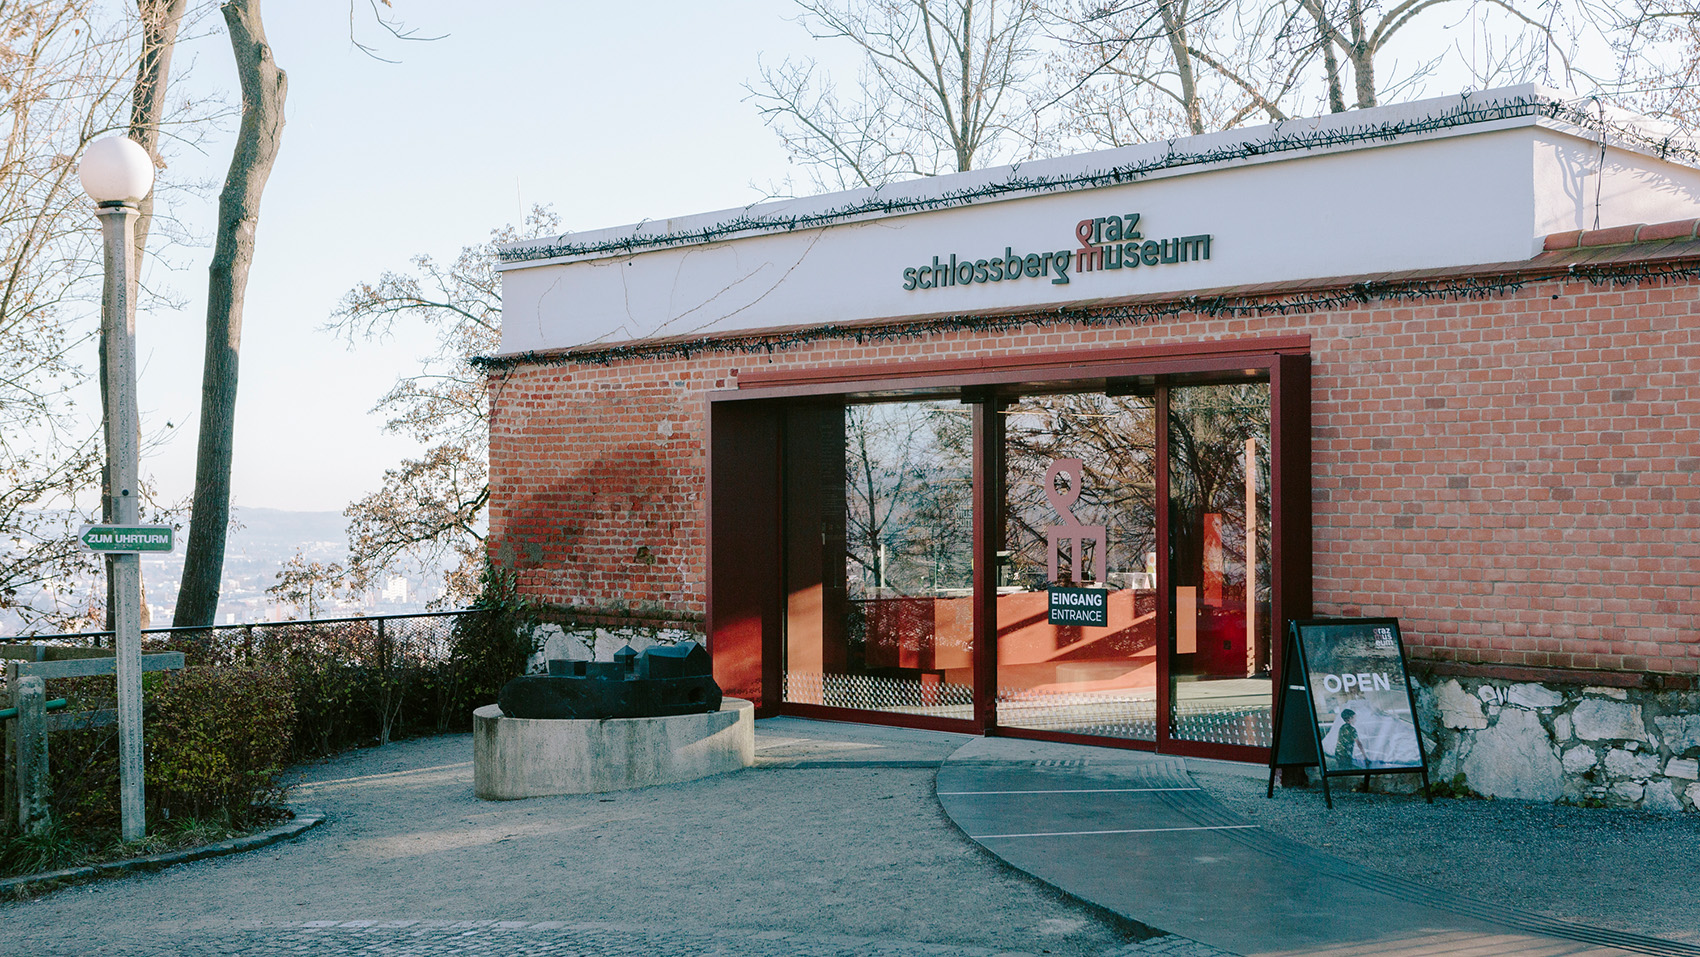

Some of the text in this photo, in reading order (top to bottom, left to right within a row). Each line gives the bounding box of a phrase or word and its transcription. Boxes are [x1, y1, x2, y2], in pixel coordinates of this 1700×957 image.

[1075, 213, 1142, 248] graz
[902, 234, 1210, 291] schlossberg museum
[88, 534, 169, 543] ZUM UHRTURM
[1051, 592, 1102, 607] EINGANG
[1051, 608, 1102, 622] ENTRANCE
[1323, 672, 1391, 693] OPEN
